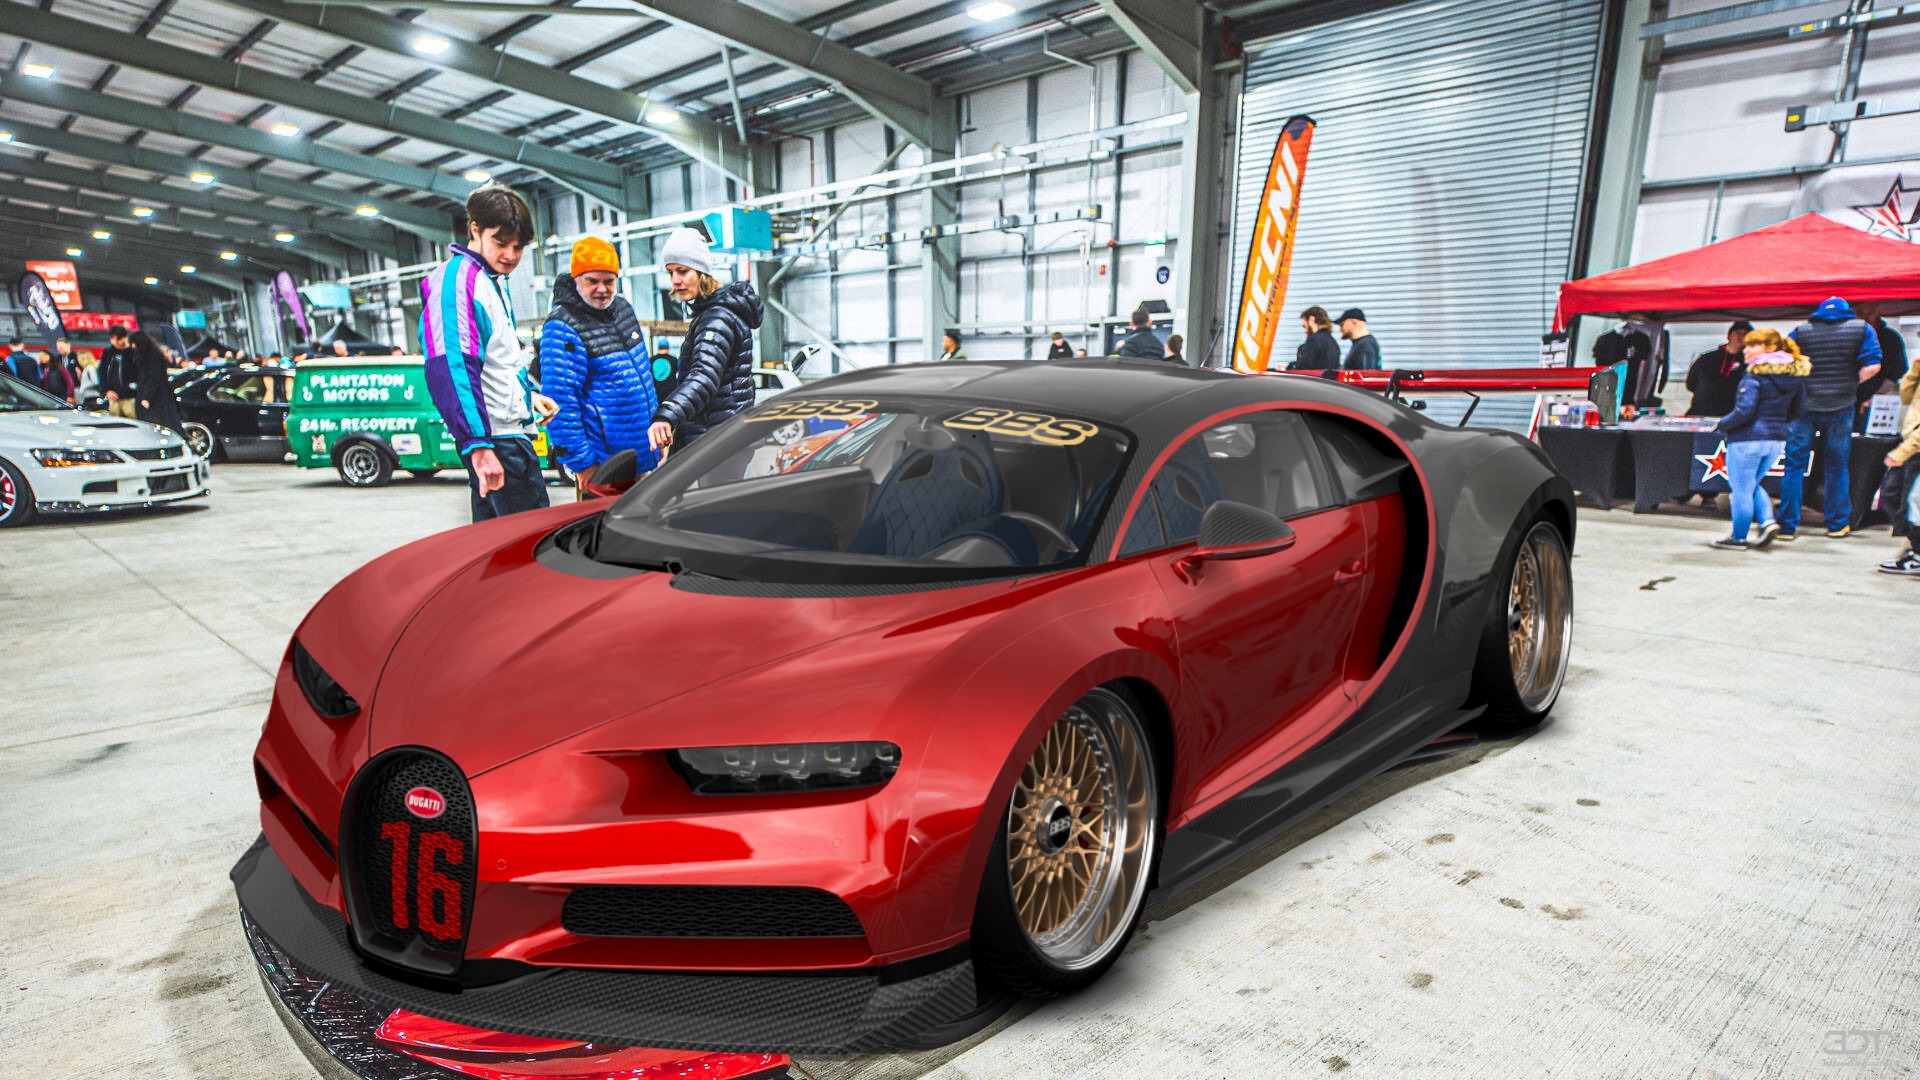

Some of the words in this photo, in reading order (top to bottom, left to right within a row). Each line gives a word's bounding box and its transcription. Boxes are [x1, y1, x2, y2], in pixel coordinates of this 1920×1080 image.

[310, 374, 405, 388] PLANTATION
[323, 388, 389, 402] MOTORS
[744, 400, 878, 423] BBS
[341, 417, 418, 431] RECOVERY
[943, 407, 1098, 446] BBS
[409, 795, 440, 811] BUGATTI
[1049, 816, 1071, 836] BBS
[381, 821, 463, 940] 16
